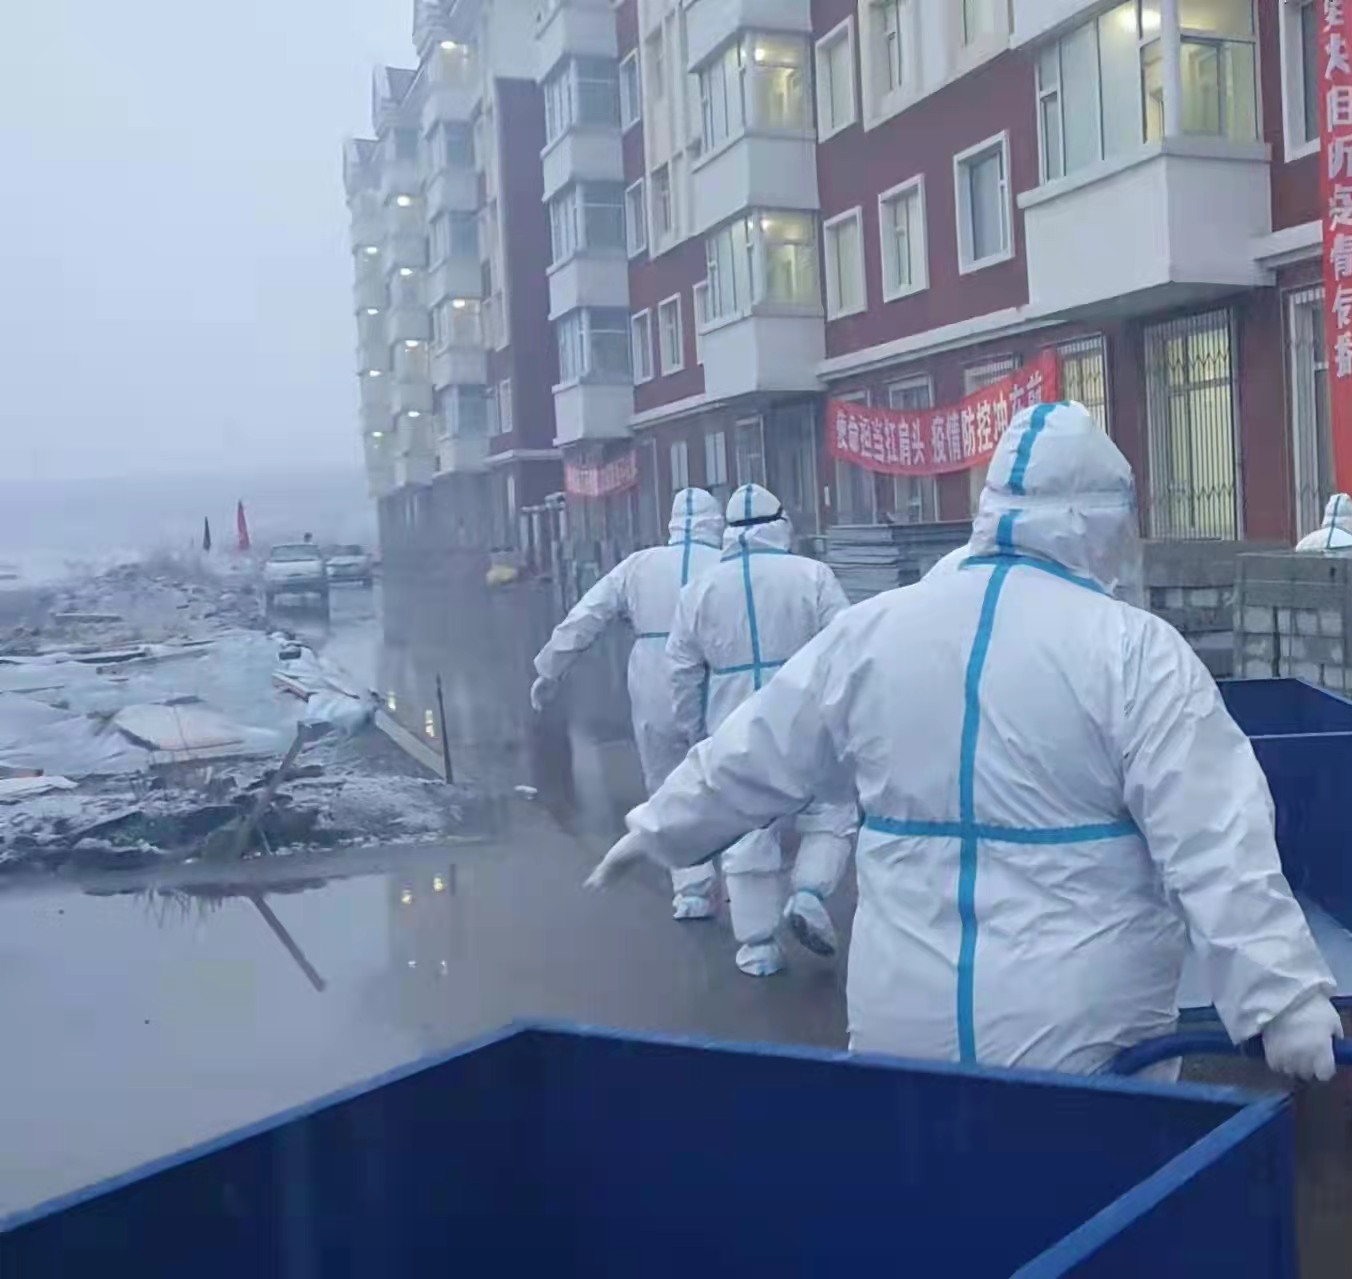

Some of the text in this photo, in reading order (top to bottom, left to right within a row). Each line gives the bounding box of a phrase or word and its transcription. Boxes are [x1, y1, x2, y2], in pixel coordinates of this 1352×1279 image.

[836, 409, 926, 466] 使命担当扛肩头
